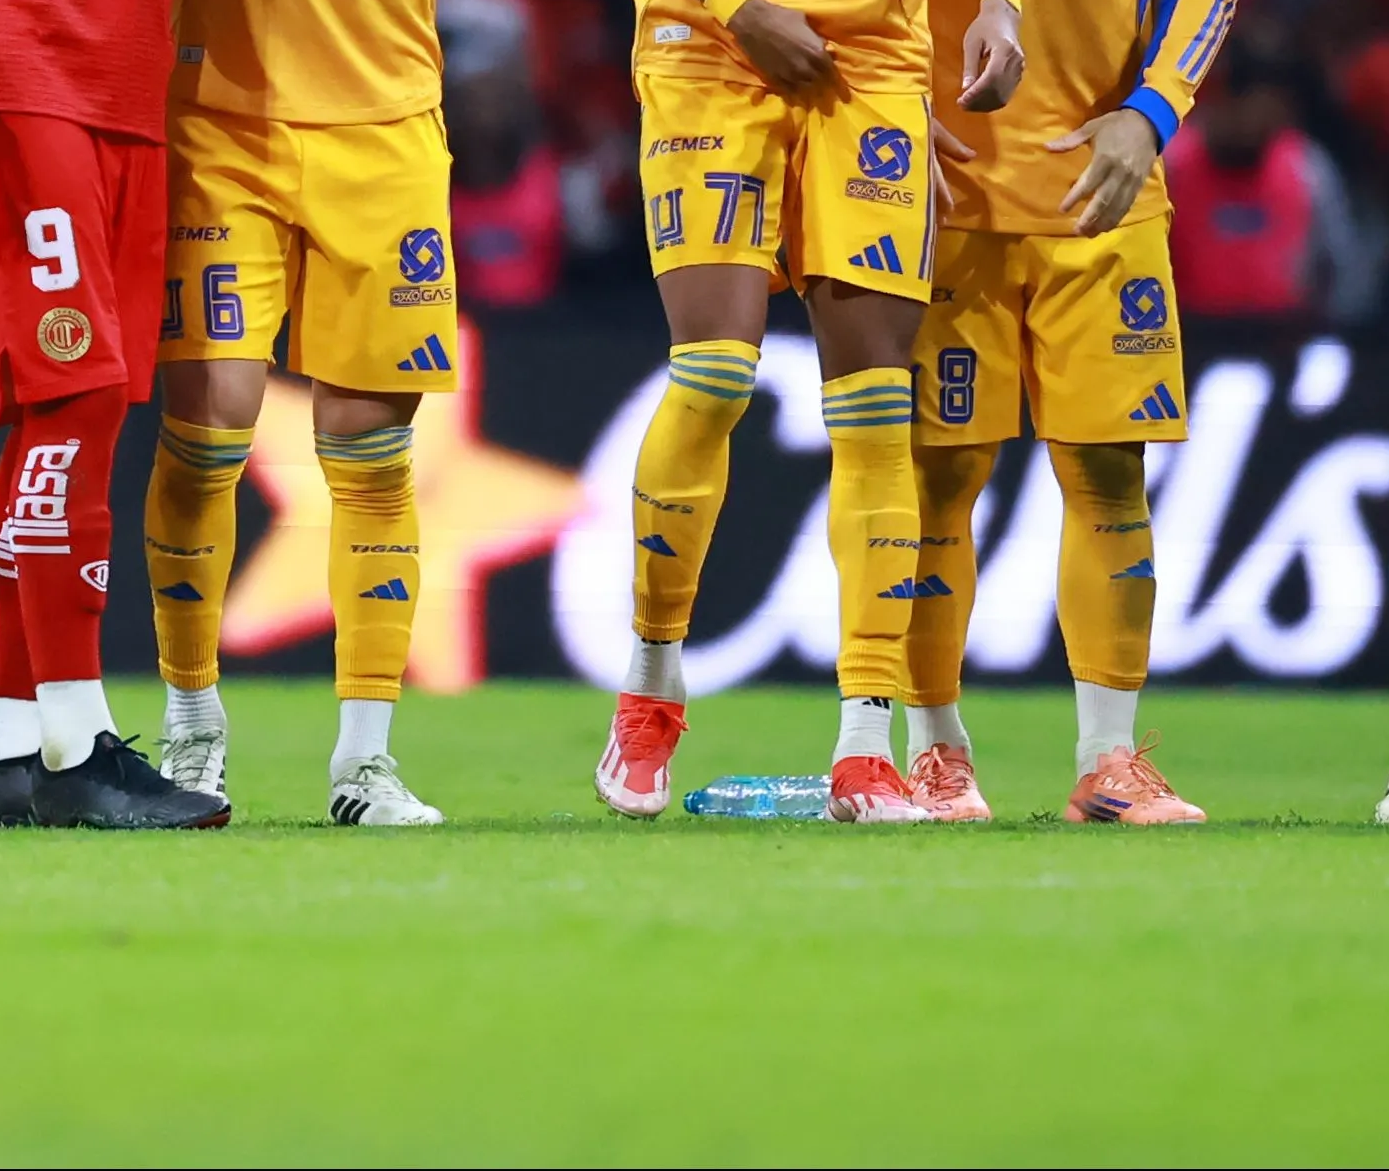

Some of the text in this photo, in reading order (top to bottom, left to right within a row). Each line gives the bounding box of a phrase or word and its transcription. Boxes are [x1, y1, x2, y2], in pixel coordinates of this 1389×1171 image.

[661, 136, 725, 153] CEMEX
[877, 186, 914, 205] GAS
[704, 172, 765, 248] 77
[171, 226, 231, 241] EMEX
[24, 207, 81, 292] 9
[202, 264, 244, 341] 6
[422, 287, 452, 303] GAS
[1145, 336, 1176, 350] GAS
[939, 347, 977, 424] 8
